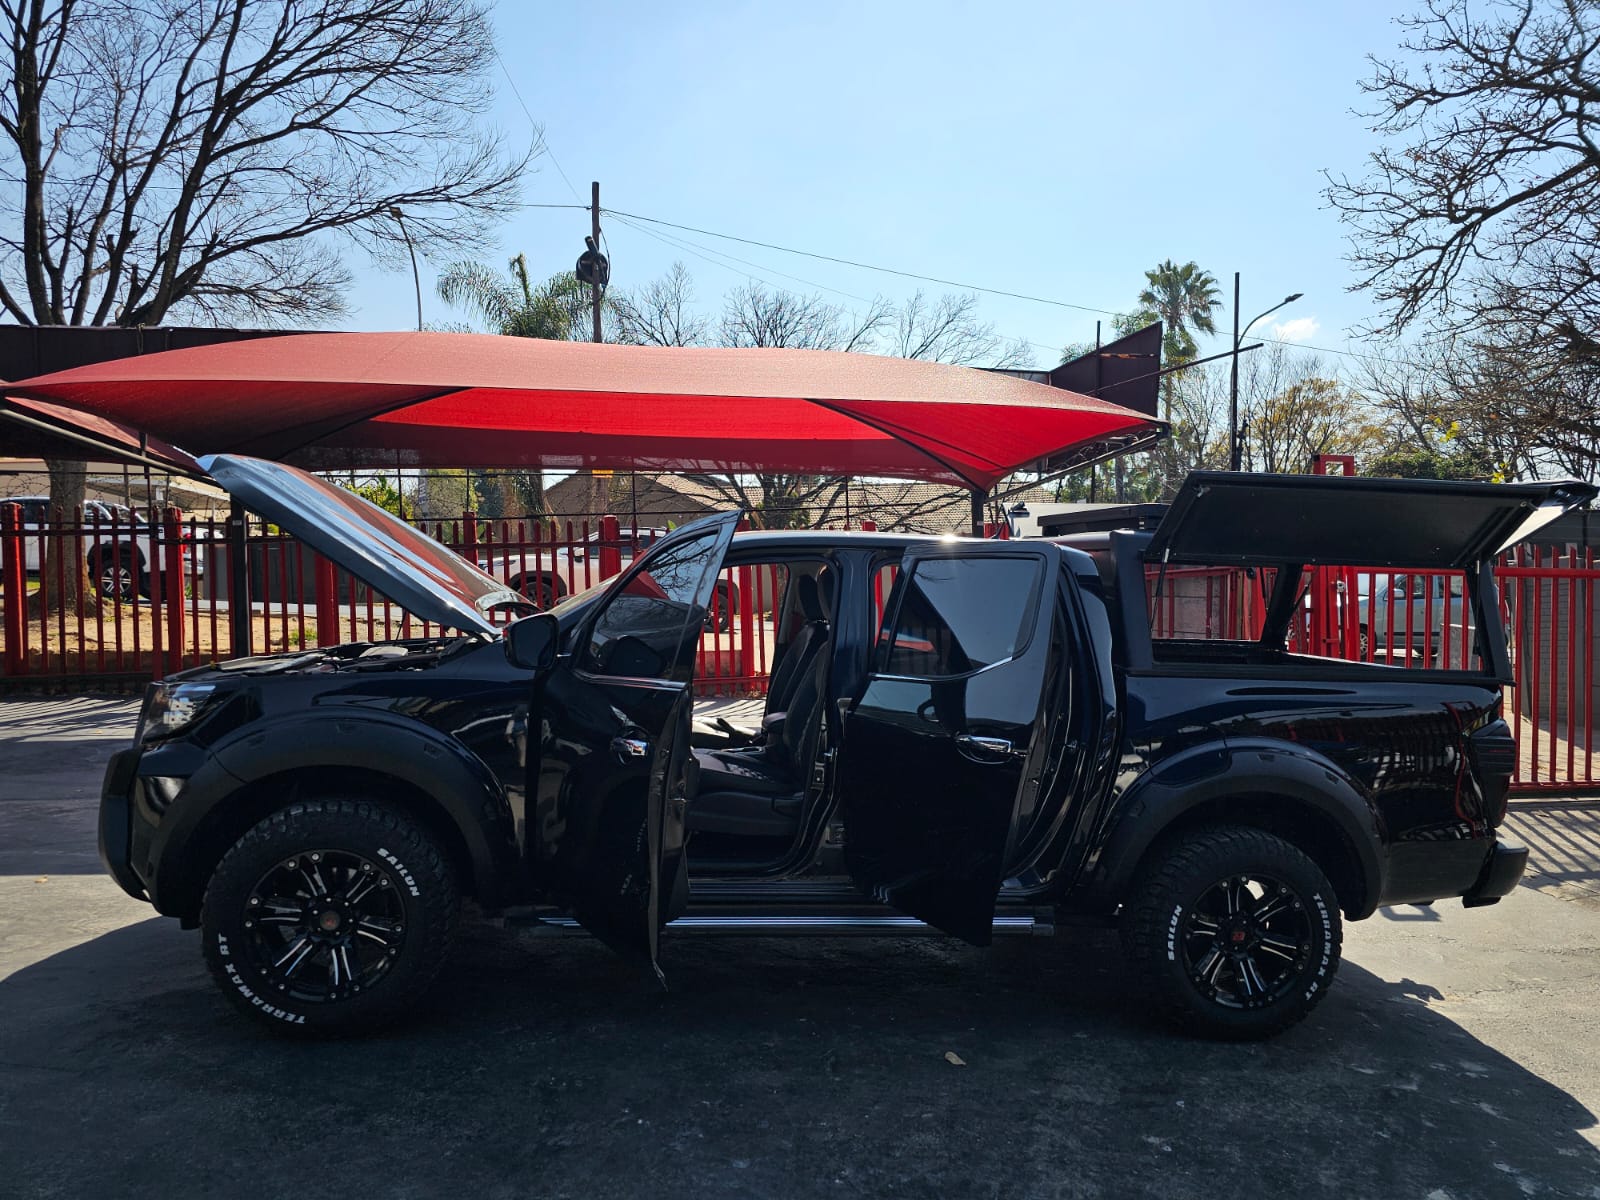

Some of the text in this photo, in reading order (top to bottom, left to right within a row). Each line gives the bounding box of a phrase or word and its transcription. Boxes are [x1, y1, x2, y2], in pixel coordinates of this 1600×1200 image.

[376, 847, 421, 897] SAILUN
[1167, 904, 1183, 961] SAILUN
[1313, 892, 1332, 977] TERRAMAX
[224, 963, 306, 1025] TERRAMAX
